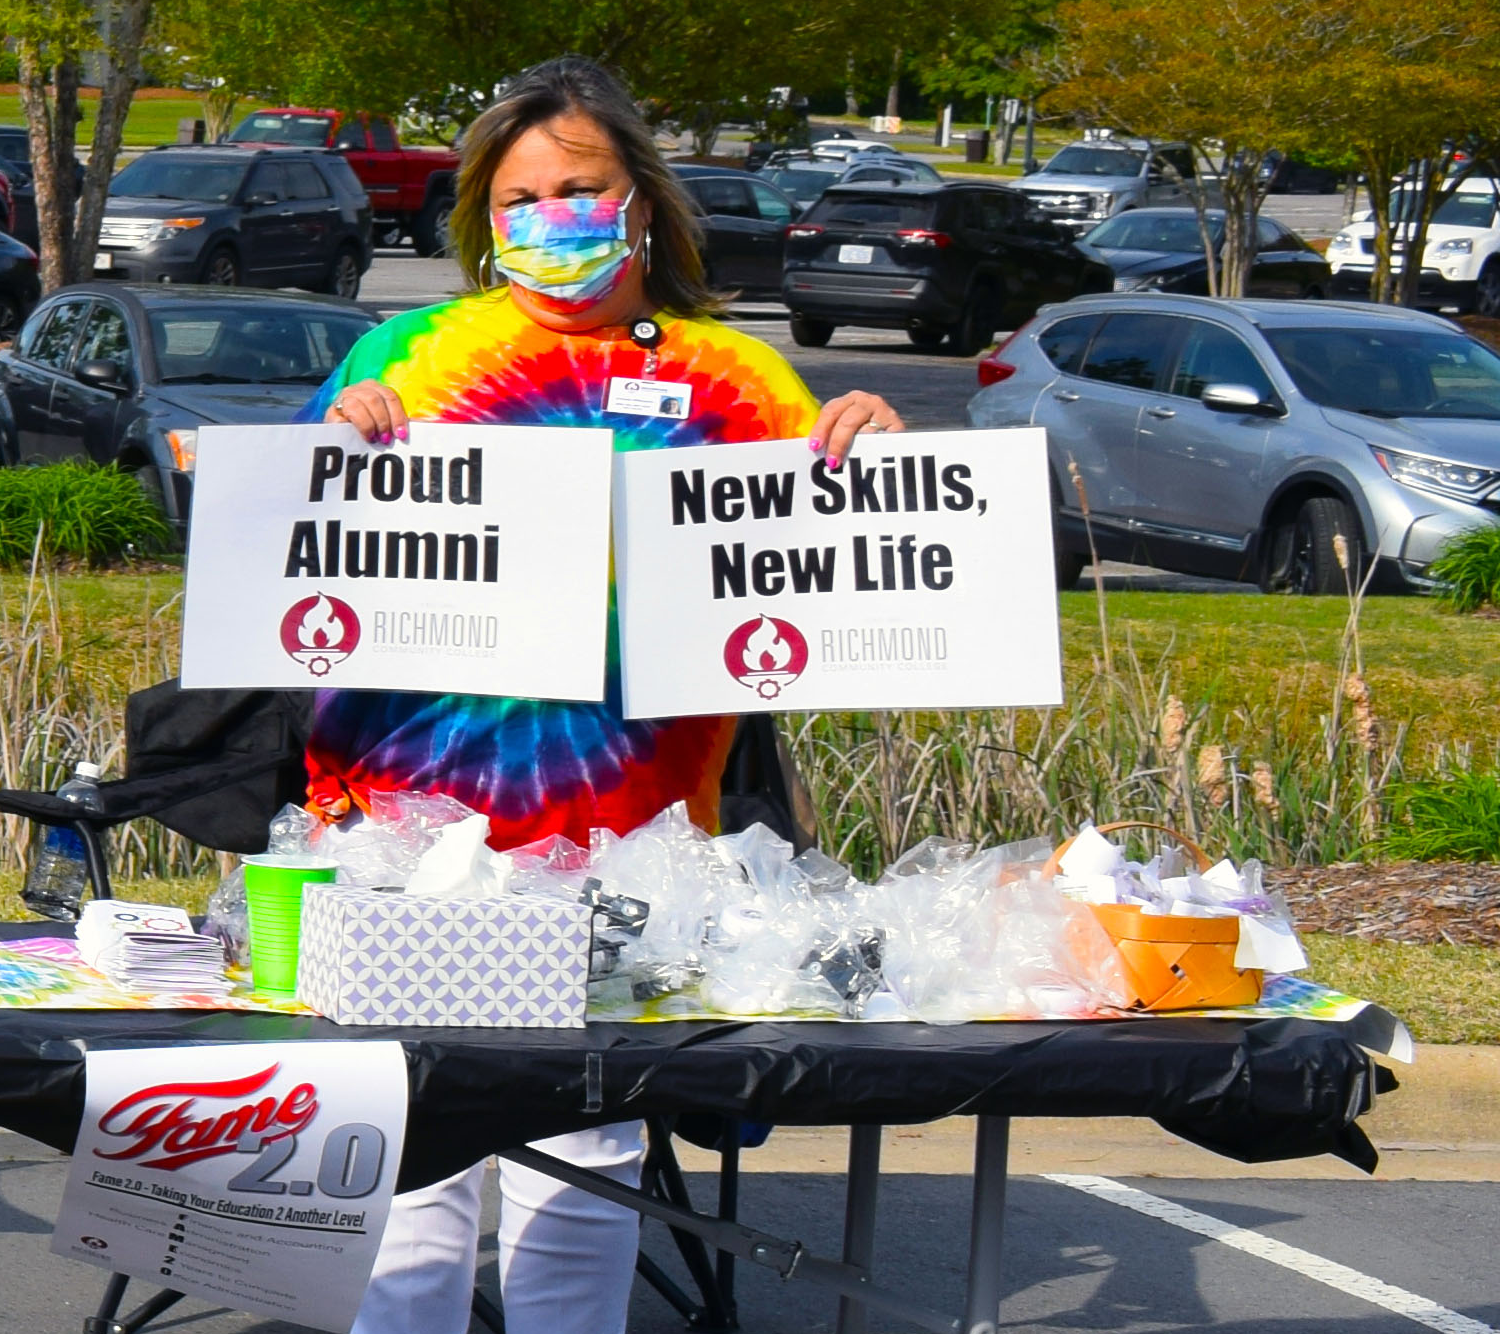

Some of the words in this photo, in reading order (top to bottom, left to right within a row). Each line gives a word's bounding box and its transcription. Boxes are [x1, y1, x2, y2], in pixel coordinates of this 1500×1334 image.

[308, 446, 483, 505] Proud
[672, 469, 795, 525] New
[811, 454, 987, 516] Skills,
[284, 520, 499, 582] Alumni
[712, 542, 836, 599] New
[853, 535, 953, 590] Life
[373, 646, 442, 655] COMMUNITY
[445, 648, 497, 658] COLLEGE
[374, 611, 498, 648] RICHMOND
[821, 628, 947, 662] RICHMOND
[93, 1061, 319, 1170] Fame
[228, 1123, 386, 1200] 2.0
[92, 1171, 122, 1187] Fame
[124, 1178, 143, 1192] 2.0
[151, 1184, 187, 1206] Taking
[191, 1194, 215, 1210] Your
[217, 1199, 274, 1220] Education
[275, 1207, 284, 1221] 2
[285, 1207, 333, 1226] Another
[333, 1210, 366, 1227] Level
[163, 1255, 176, 1265] 2
[237, 1231, 262, 1242] and
[267, 1237, 343, 1253] Accounting
